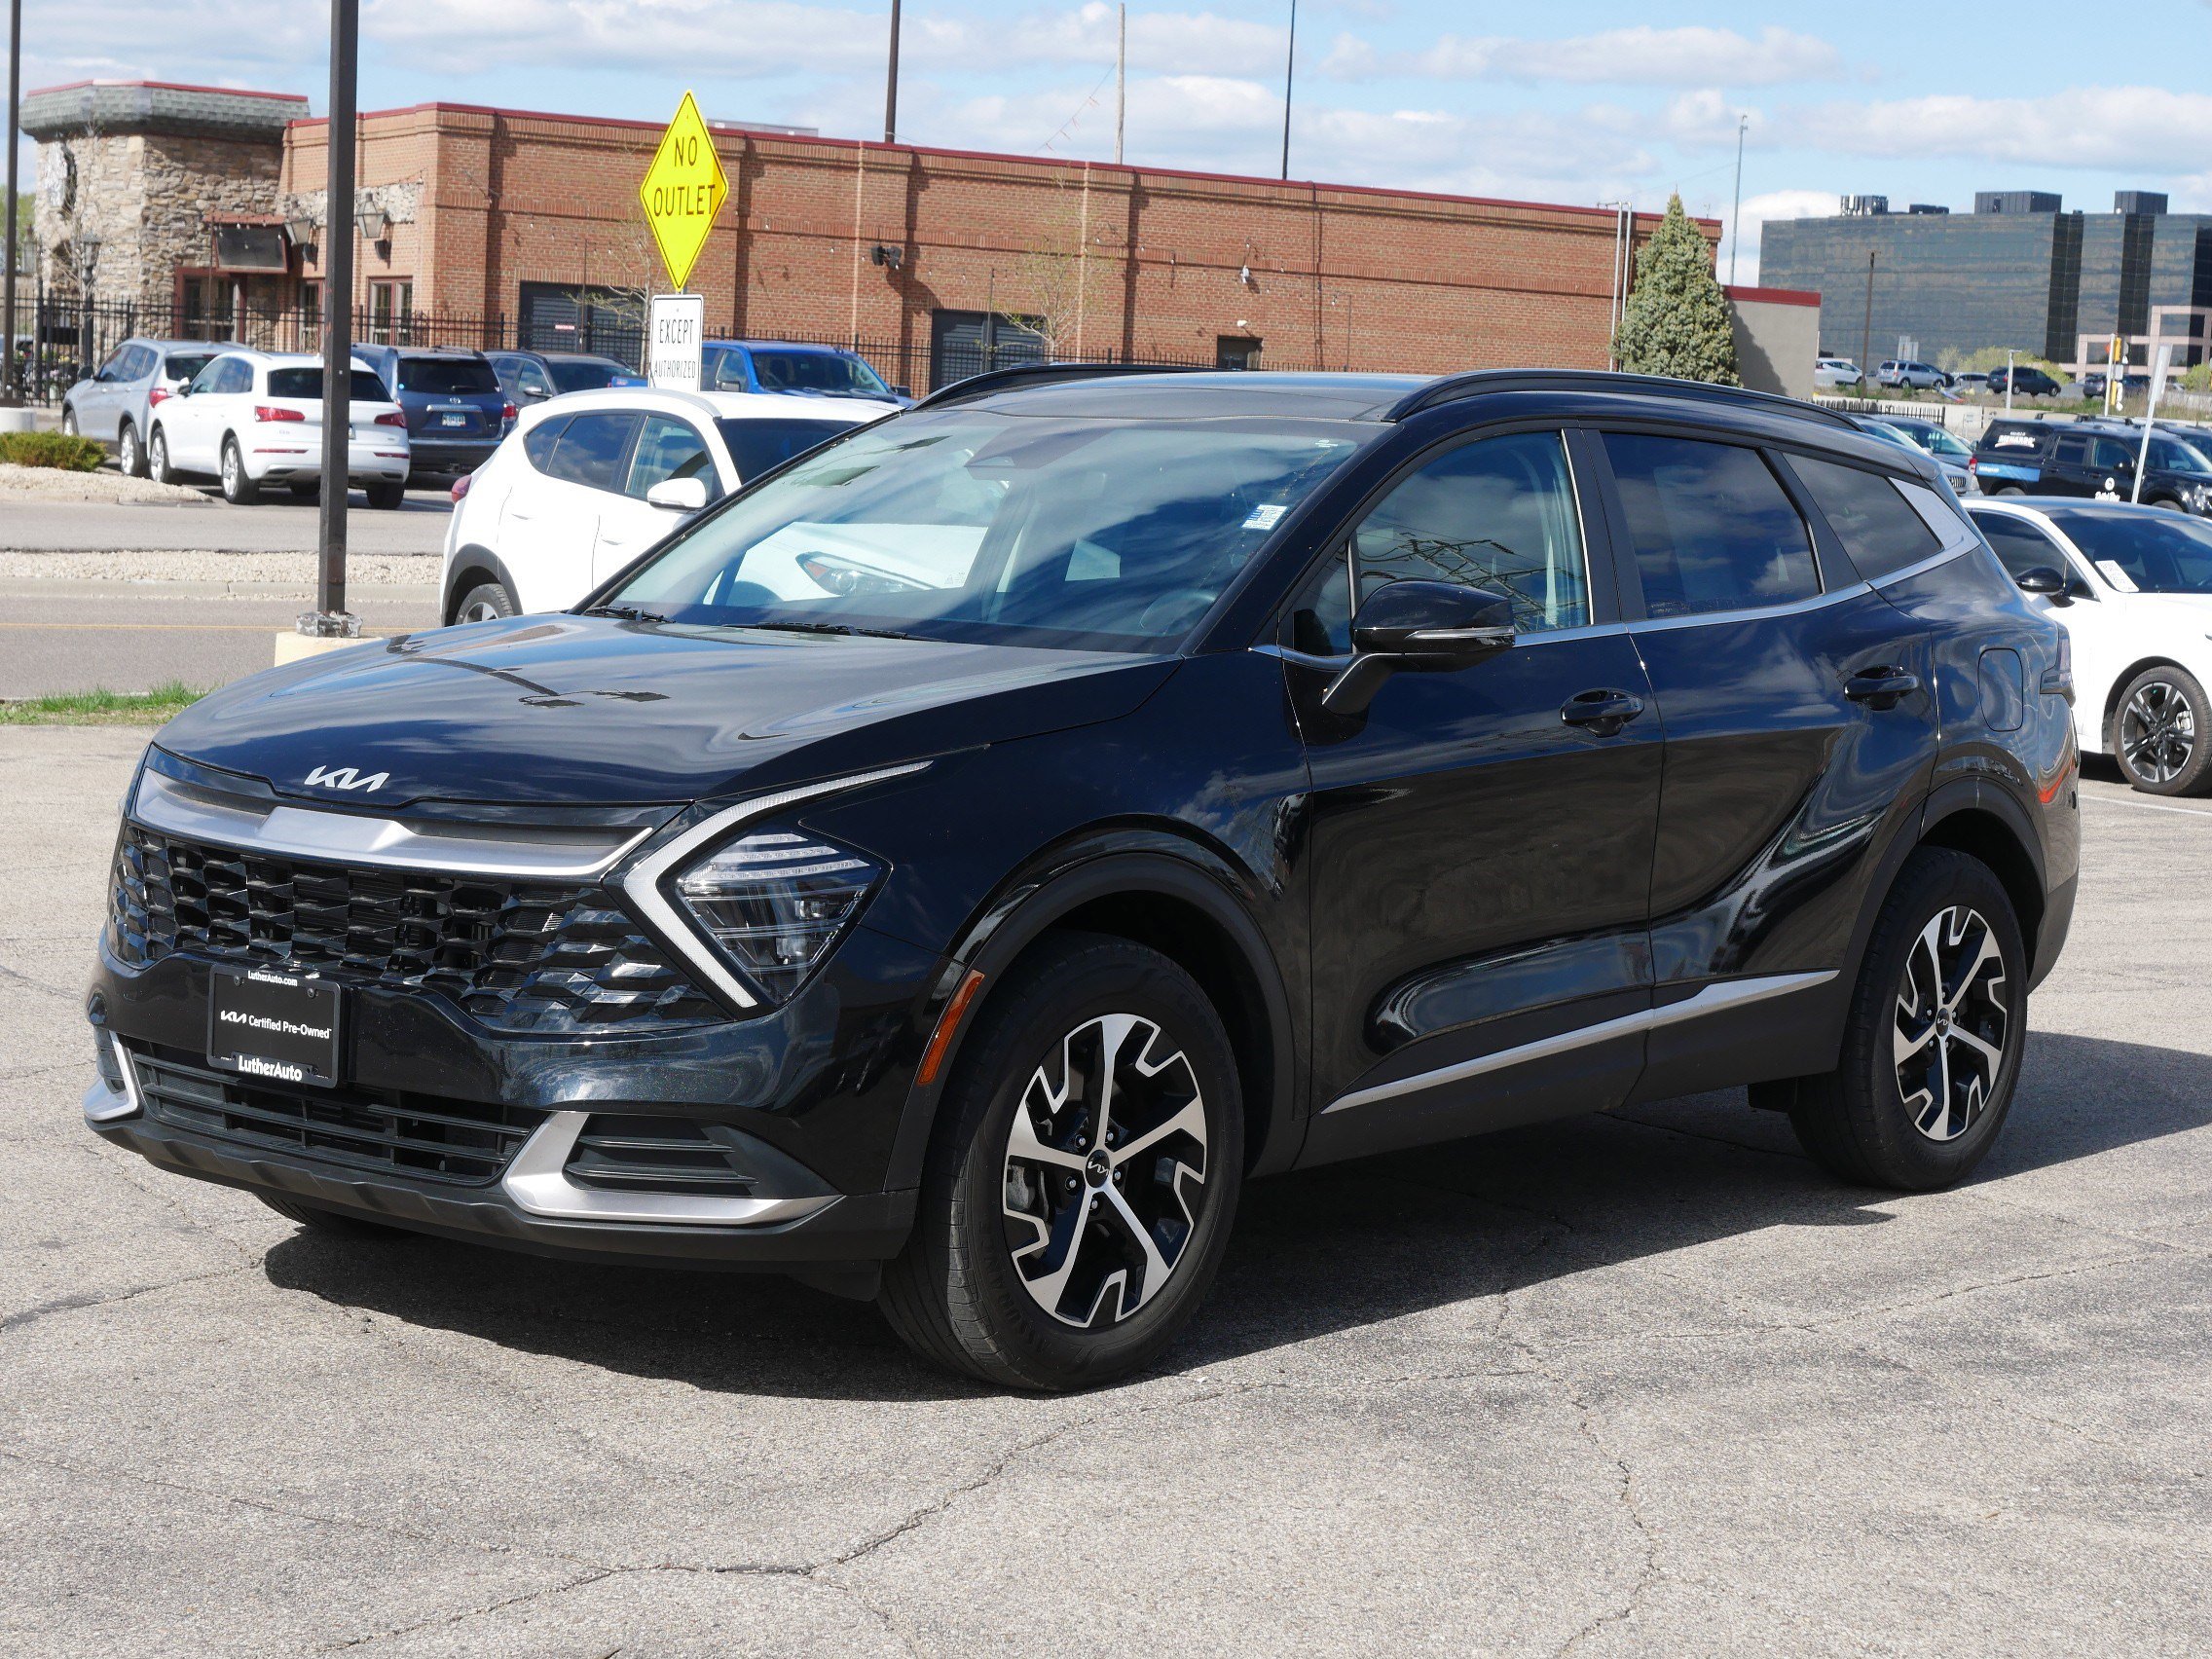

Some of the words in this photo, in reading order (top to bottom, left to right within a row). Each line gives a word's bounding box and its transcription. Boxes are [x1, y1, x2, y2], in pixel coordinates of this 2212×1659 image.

[675, 135, 698, 167] NO
[653, 184, 716, 217] OUTLET
[659, 319, 693, 344] EXCEPT
[654, 360, 696, 378] AUTHORIZED
[304, 765, 389, 793] KIA
[247, 970, 298, 986] LutherAuto.com
[220, 1010, 247, 1024] KIA
[248, 1014, 281, 1032] Certified
[282, 1020, 330, 1039] Pre-Owned
[238, 1054, 303, 1082] LutherAuto
